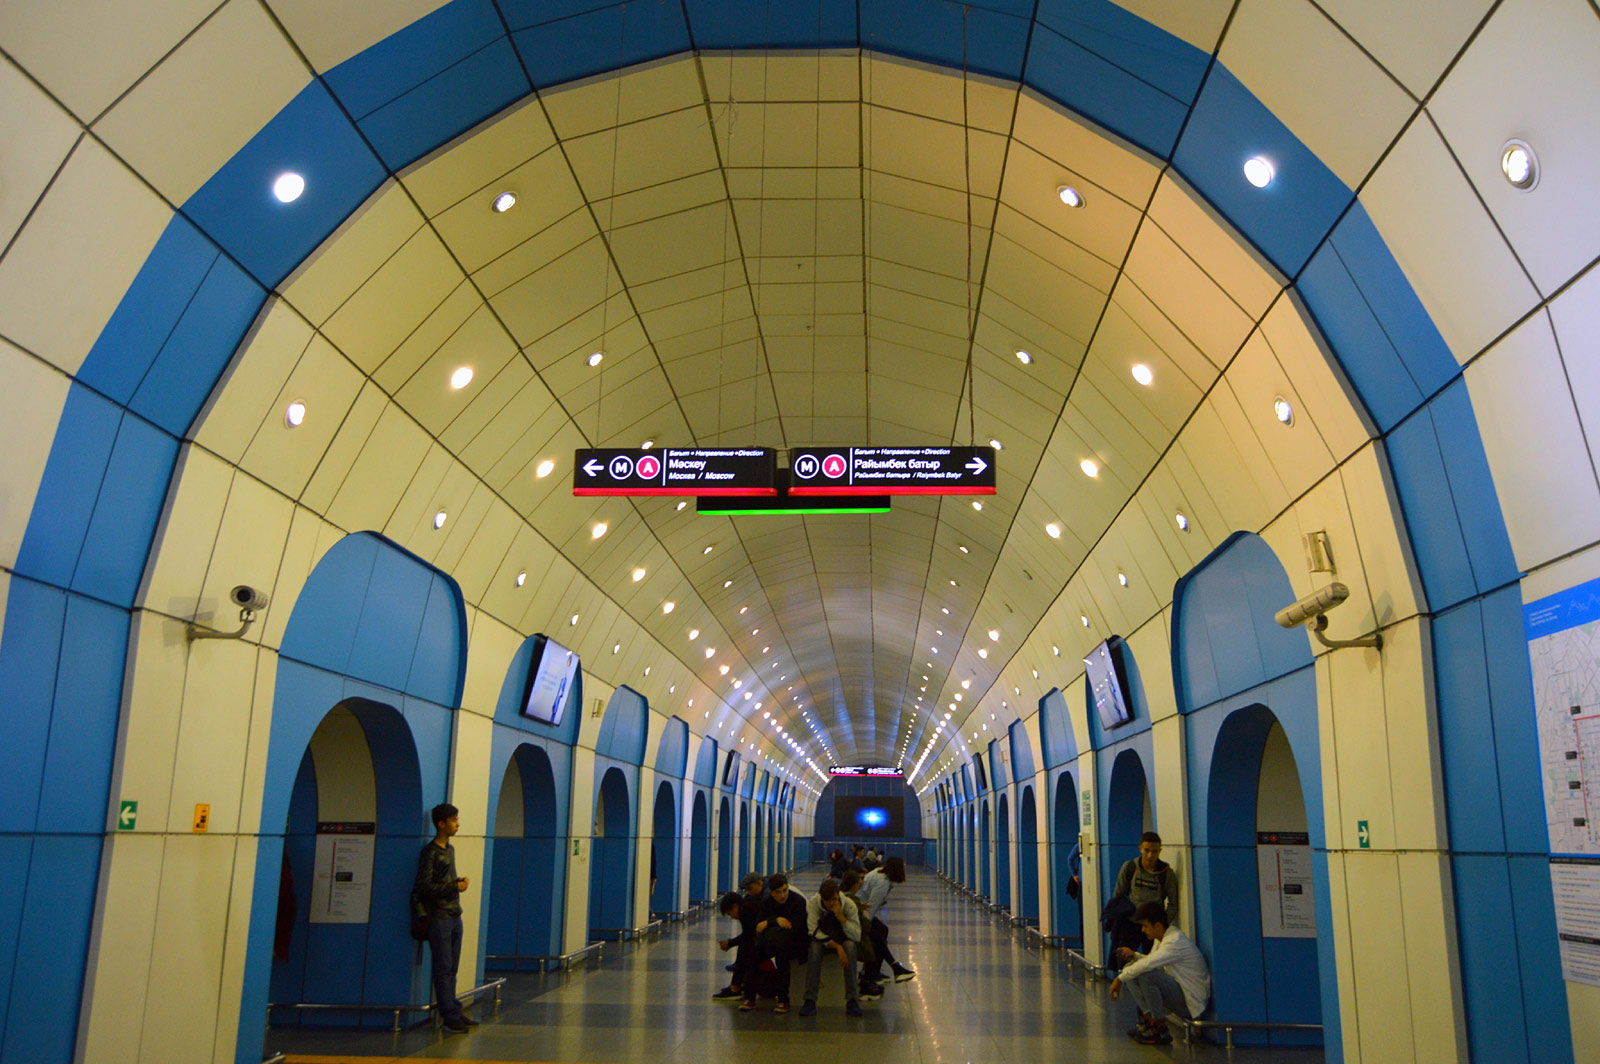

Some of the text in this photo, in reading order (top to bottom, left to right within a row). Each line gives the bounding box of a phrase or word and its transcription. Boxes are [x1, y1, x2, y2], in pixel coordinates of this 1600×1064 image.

[695, 449, 735, 458] Направление
[668, 458, 706, 471] Мәскеу
[854, 458, 941, 470] Райымбек батыр
